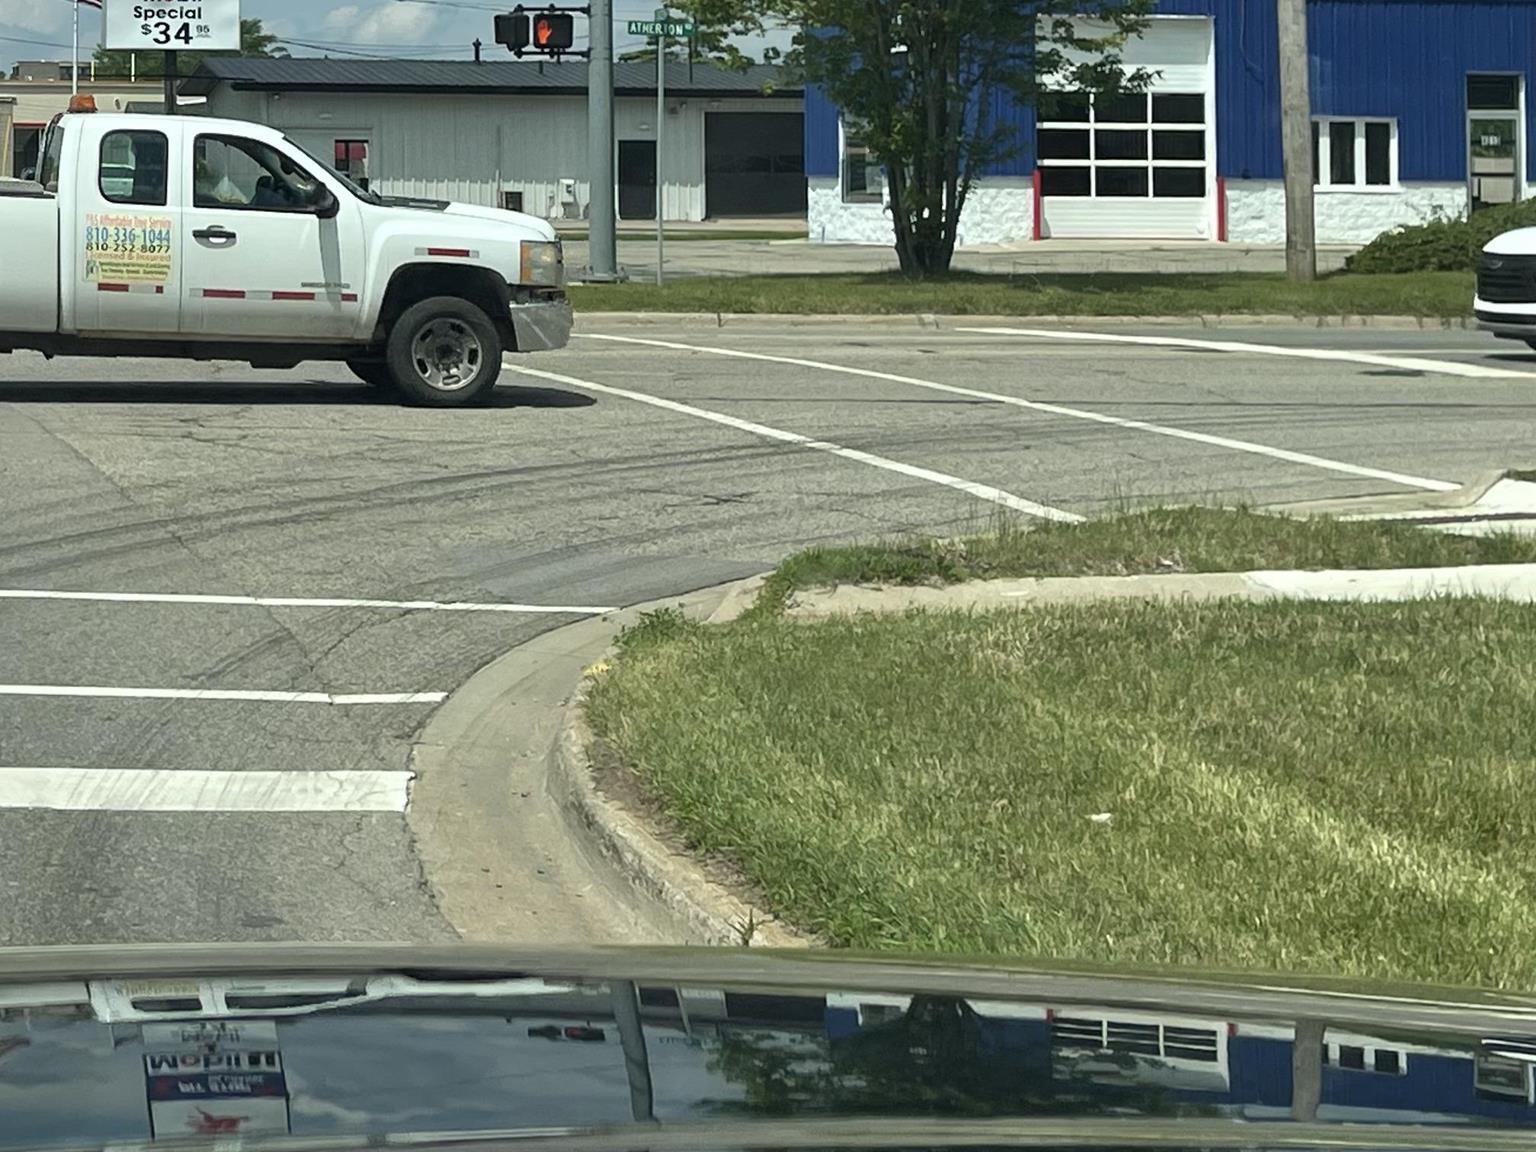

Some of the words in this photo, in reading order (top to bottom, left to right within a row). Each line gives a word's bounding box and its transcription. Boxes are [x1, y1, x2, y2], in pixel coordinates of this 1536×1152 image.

[133, 6, 202, 21] Special
[630, 22, 683, 35] ATHERTON
[86, 226, 170, 245] 810-336-1044
[86, 243, 170, 253] 810-252-8077
